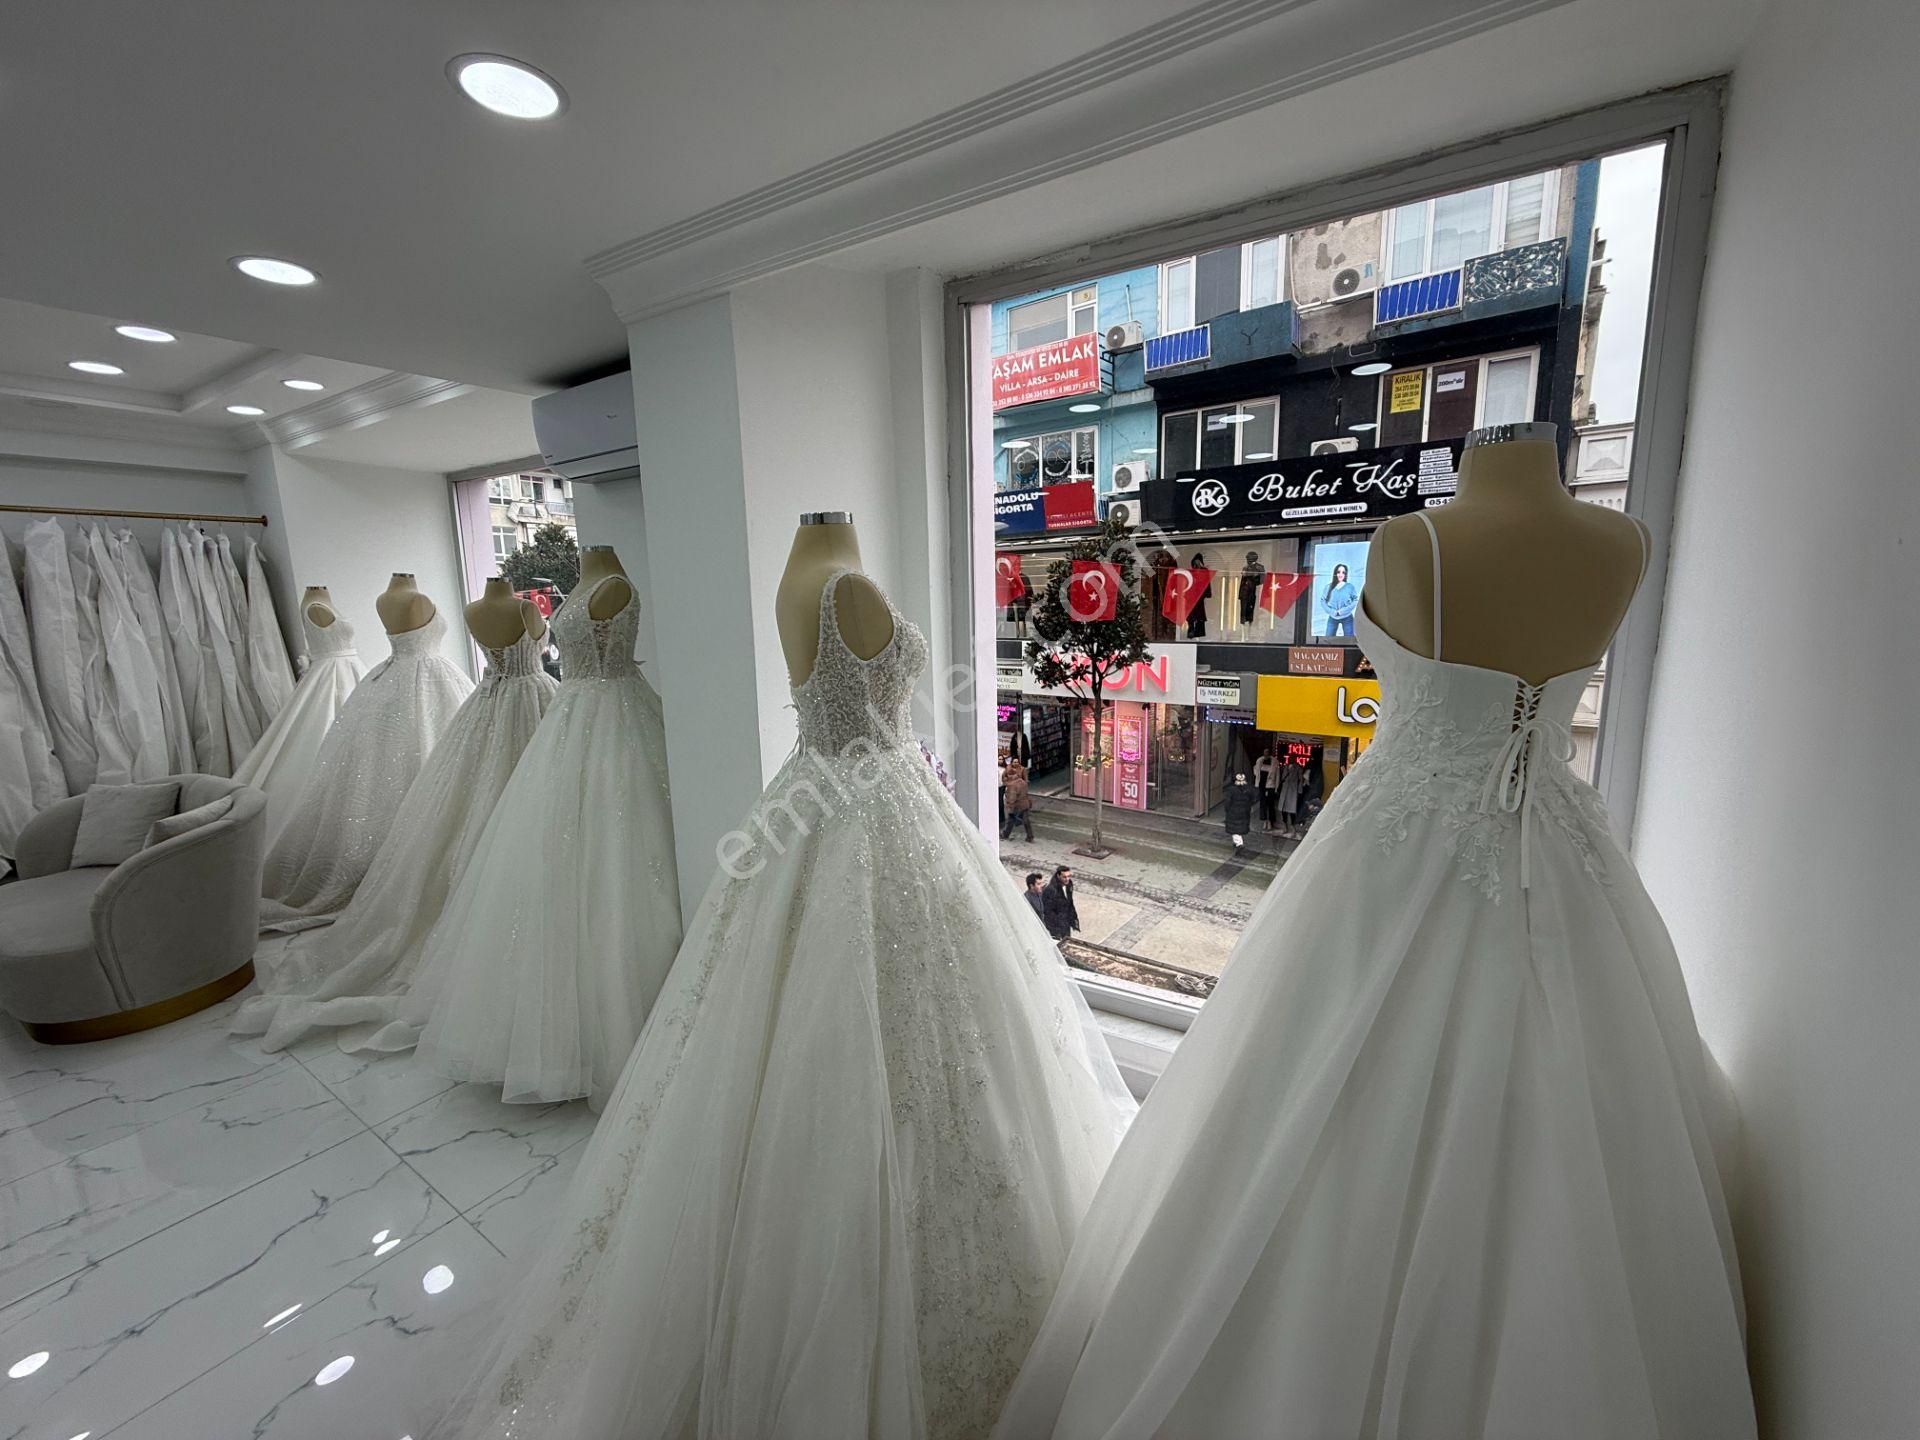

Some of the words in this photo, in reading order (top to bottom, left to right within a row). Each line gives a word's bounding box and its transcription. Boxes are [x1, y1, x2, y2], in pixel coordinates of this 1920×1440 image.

[992, 357, 1034, 380] AŞAM
[1038, 341, 1095, 369] EMLAK
[1027, 376, 1049, 388] ARSA
[1248, 469, 1343, 502] Buket
[1352, 458, 1417, 499] Kaş
[994, 491, 1039, 505] NADOLU
[994, 502, 1034, 515] İGORTA
[1197, 679, 1221, 687] NÜZHET
